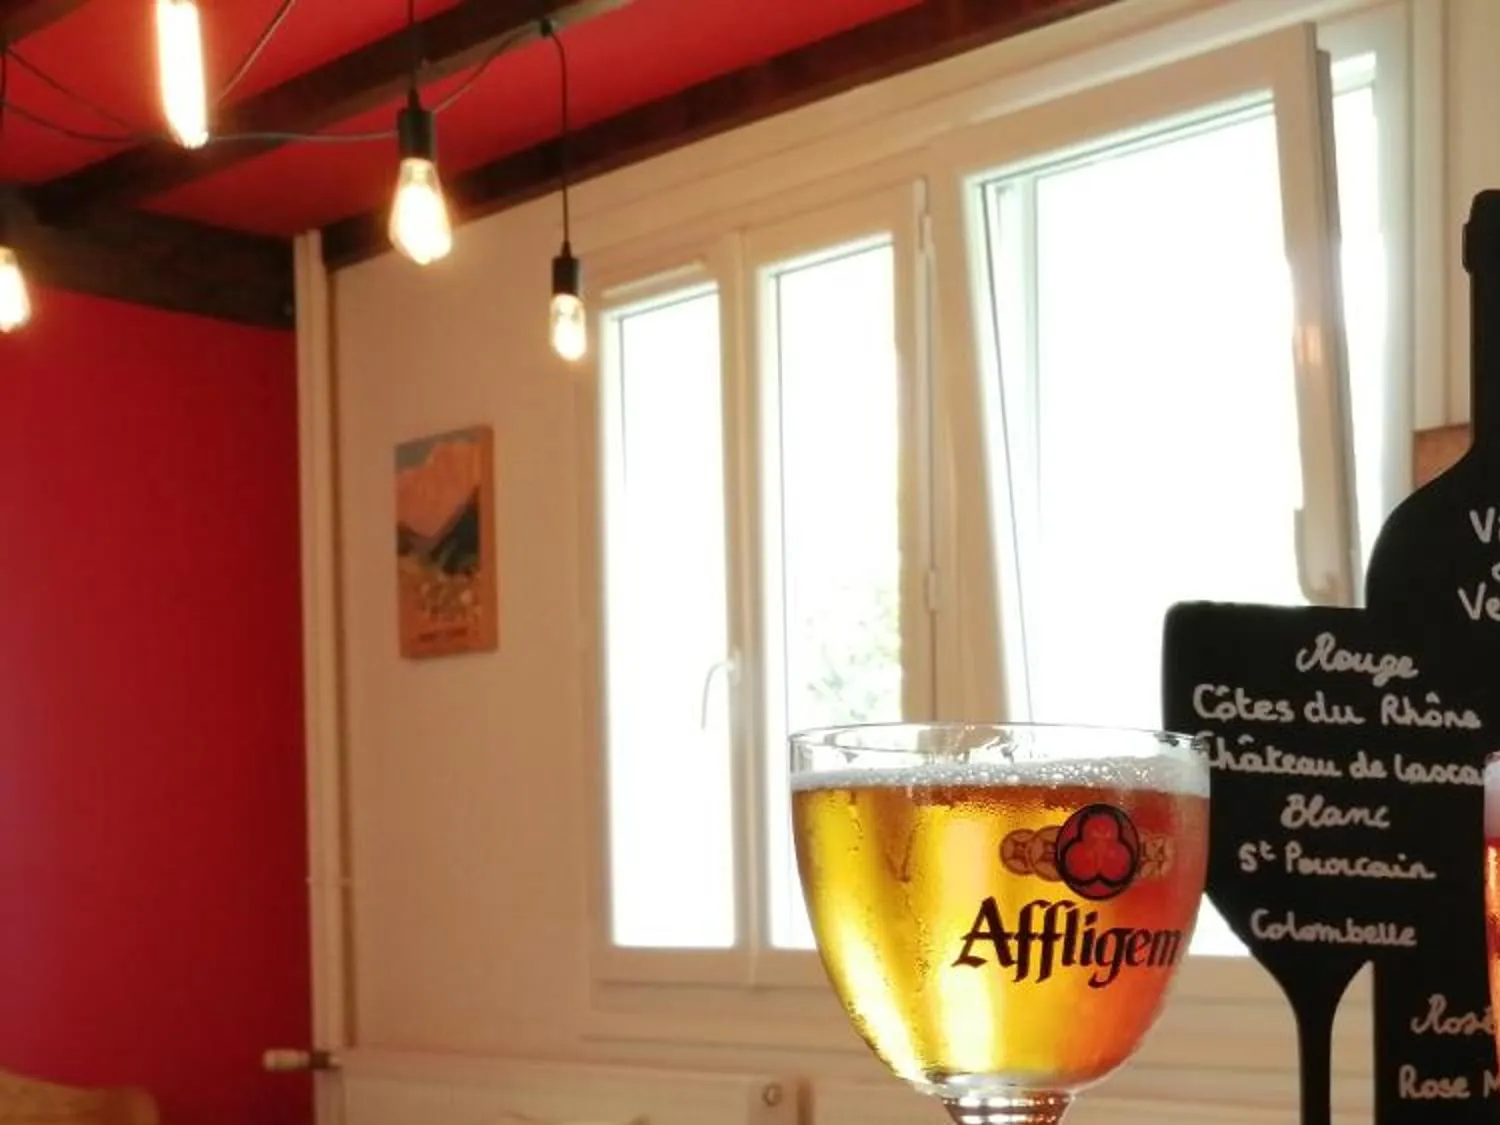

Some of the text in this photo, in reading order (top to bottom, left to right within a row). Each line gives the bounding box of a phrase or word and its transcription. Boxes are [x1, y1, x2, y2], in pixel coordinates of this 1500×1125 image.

[1296, 632, 1419, 688] Rouge
[1192, 683, 1484, 730] Côtes du Rhône
[1349, 751, 1388, 780] de
[1394, 753, 1490, 788] Lasca
[1280, 792, 1391, 829] Blanc
[951, 896, 1184, 989] Affligem
[1250, 908, 1417, 947] Colombelle
[1398, 1064, 1471, 1099] Rose
